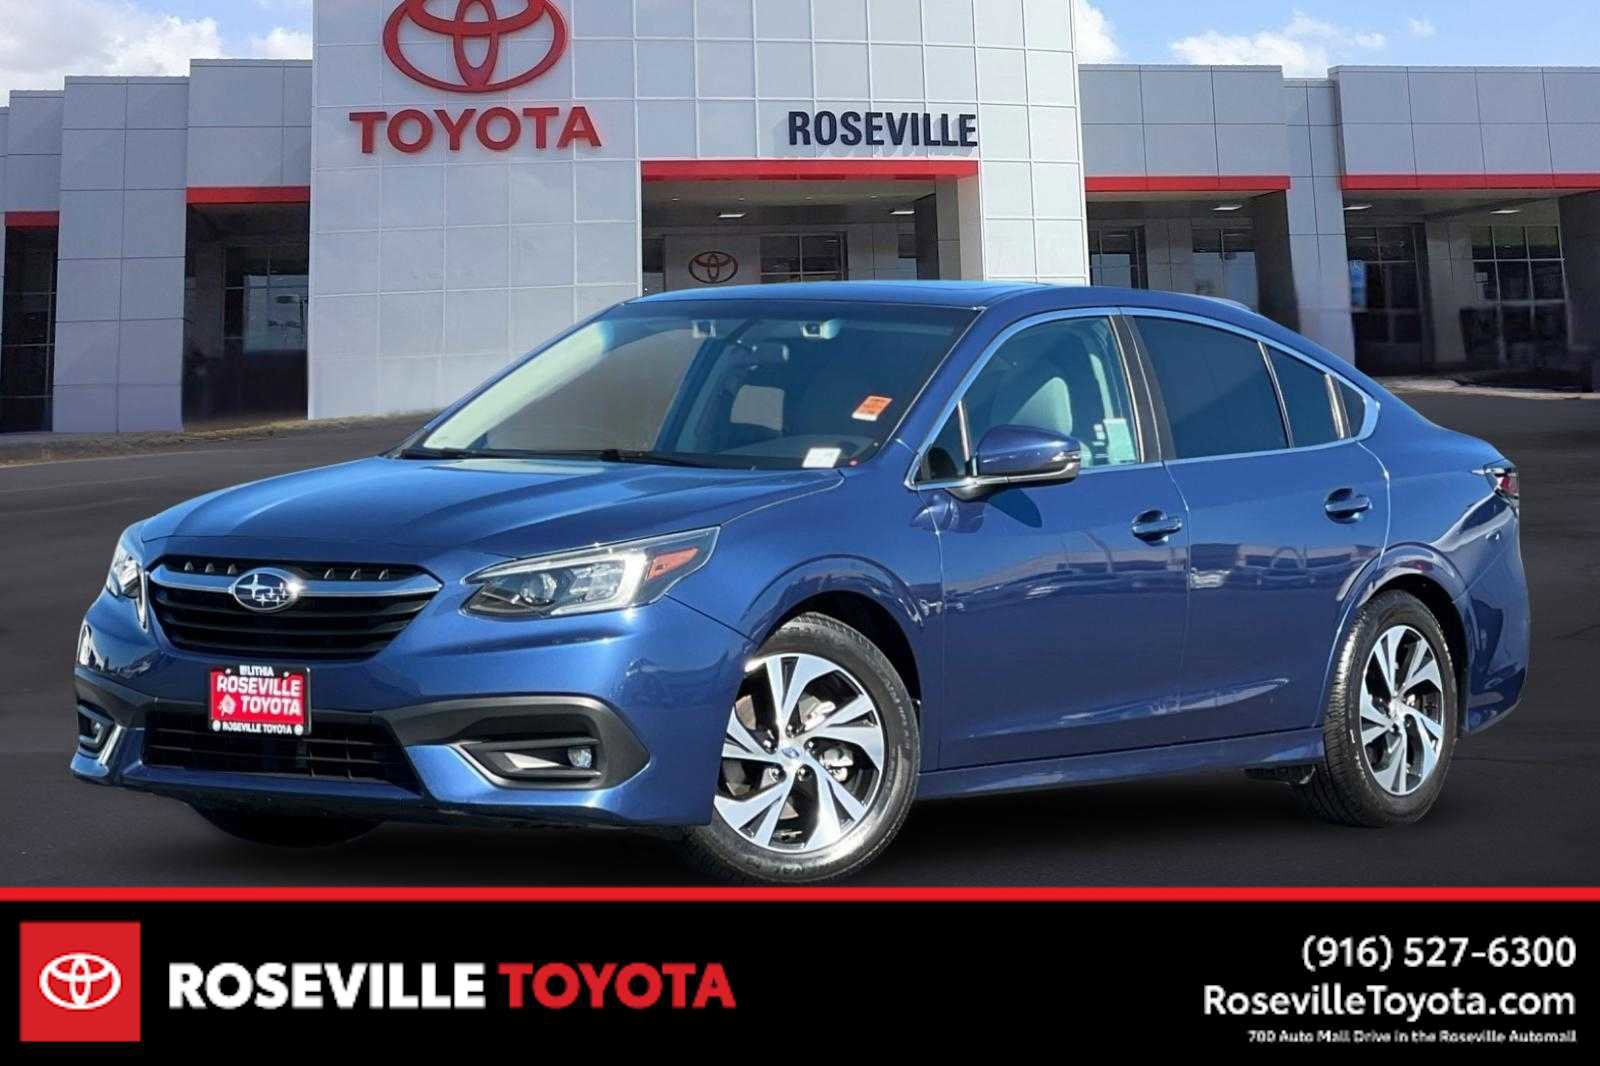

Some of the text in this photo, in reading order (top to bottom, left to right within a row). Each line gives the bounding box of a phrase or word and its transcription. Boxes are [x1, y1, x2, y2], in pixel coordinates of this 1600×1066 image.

[349, 105, 603, 154] TOYOTA
[788, 110, 979, 148] ROSEVILLE
[217, 675, 301, 697] ROSEVILLE
[241, 695, 302, 716] TOYOTA
